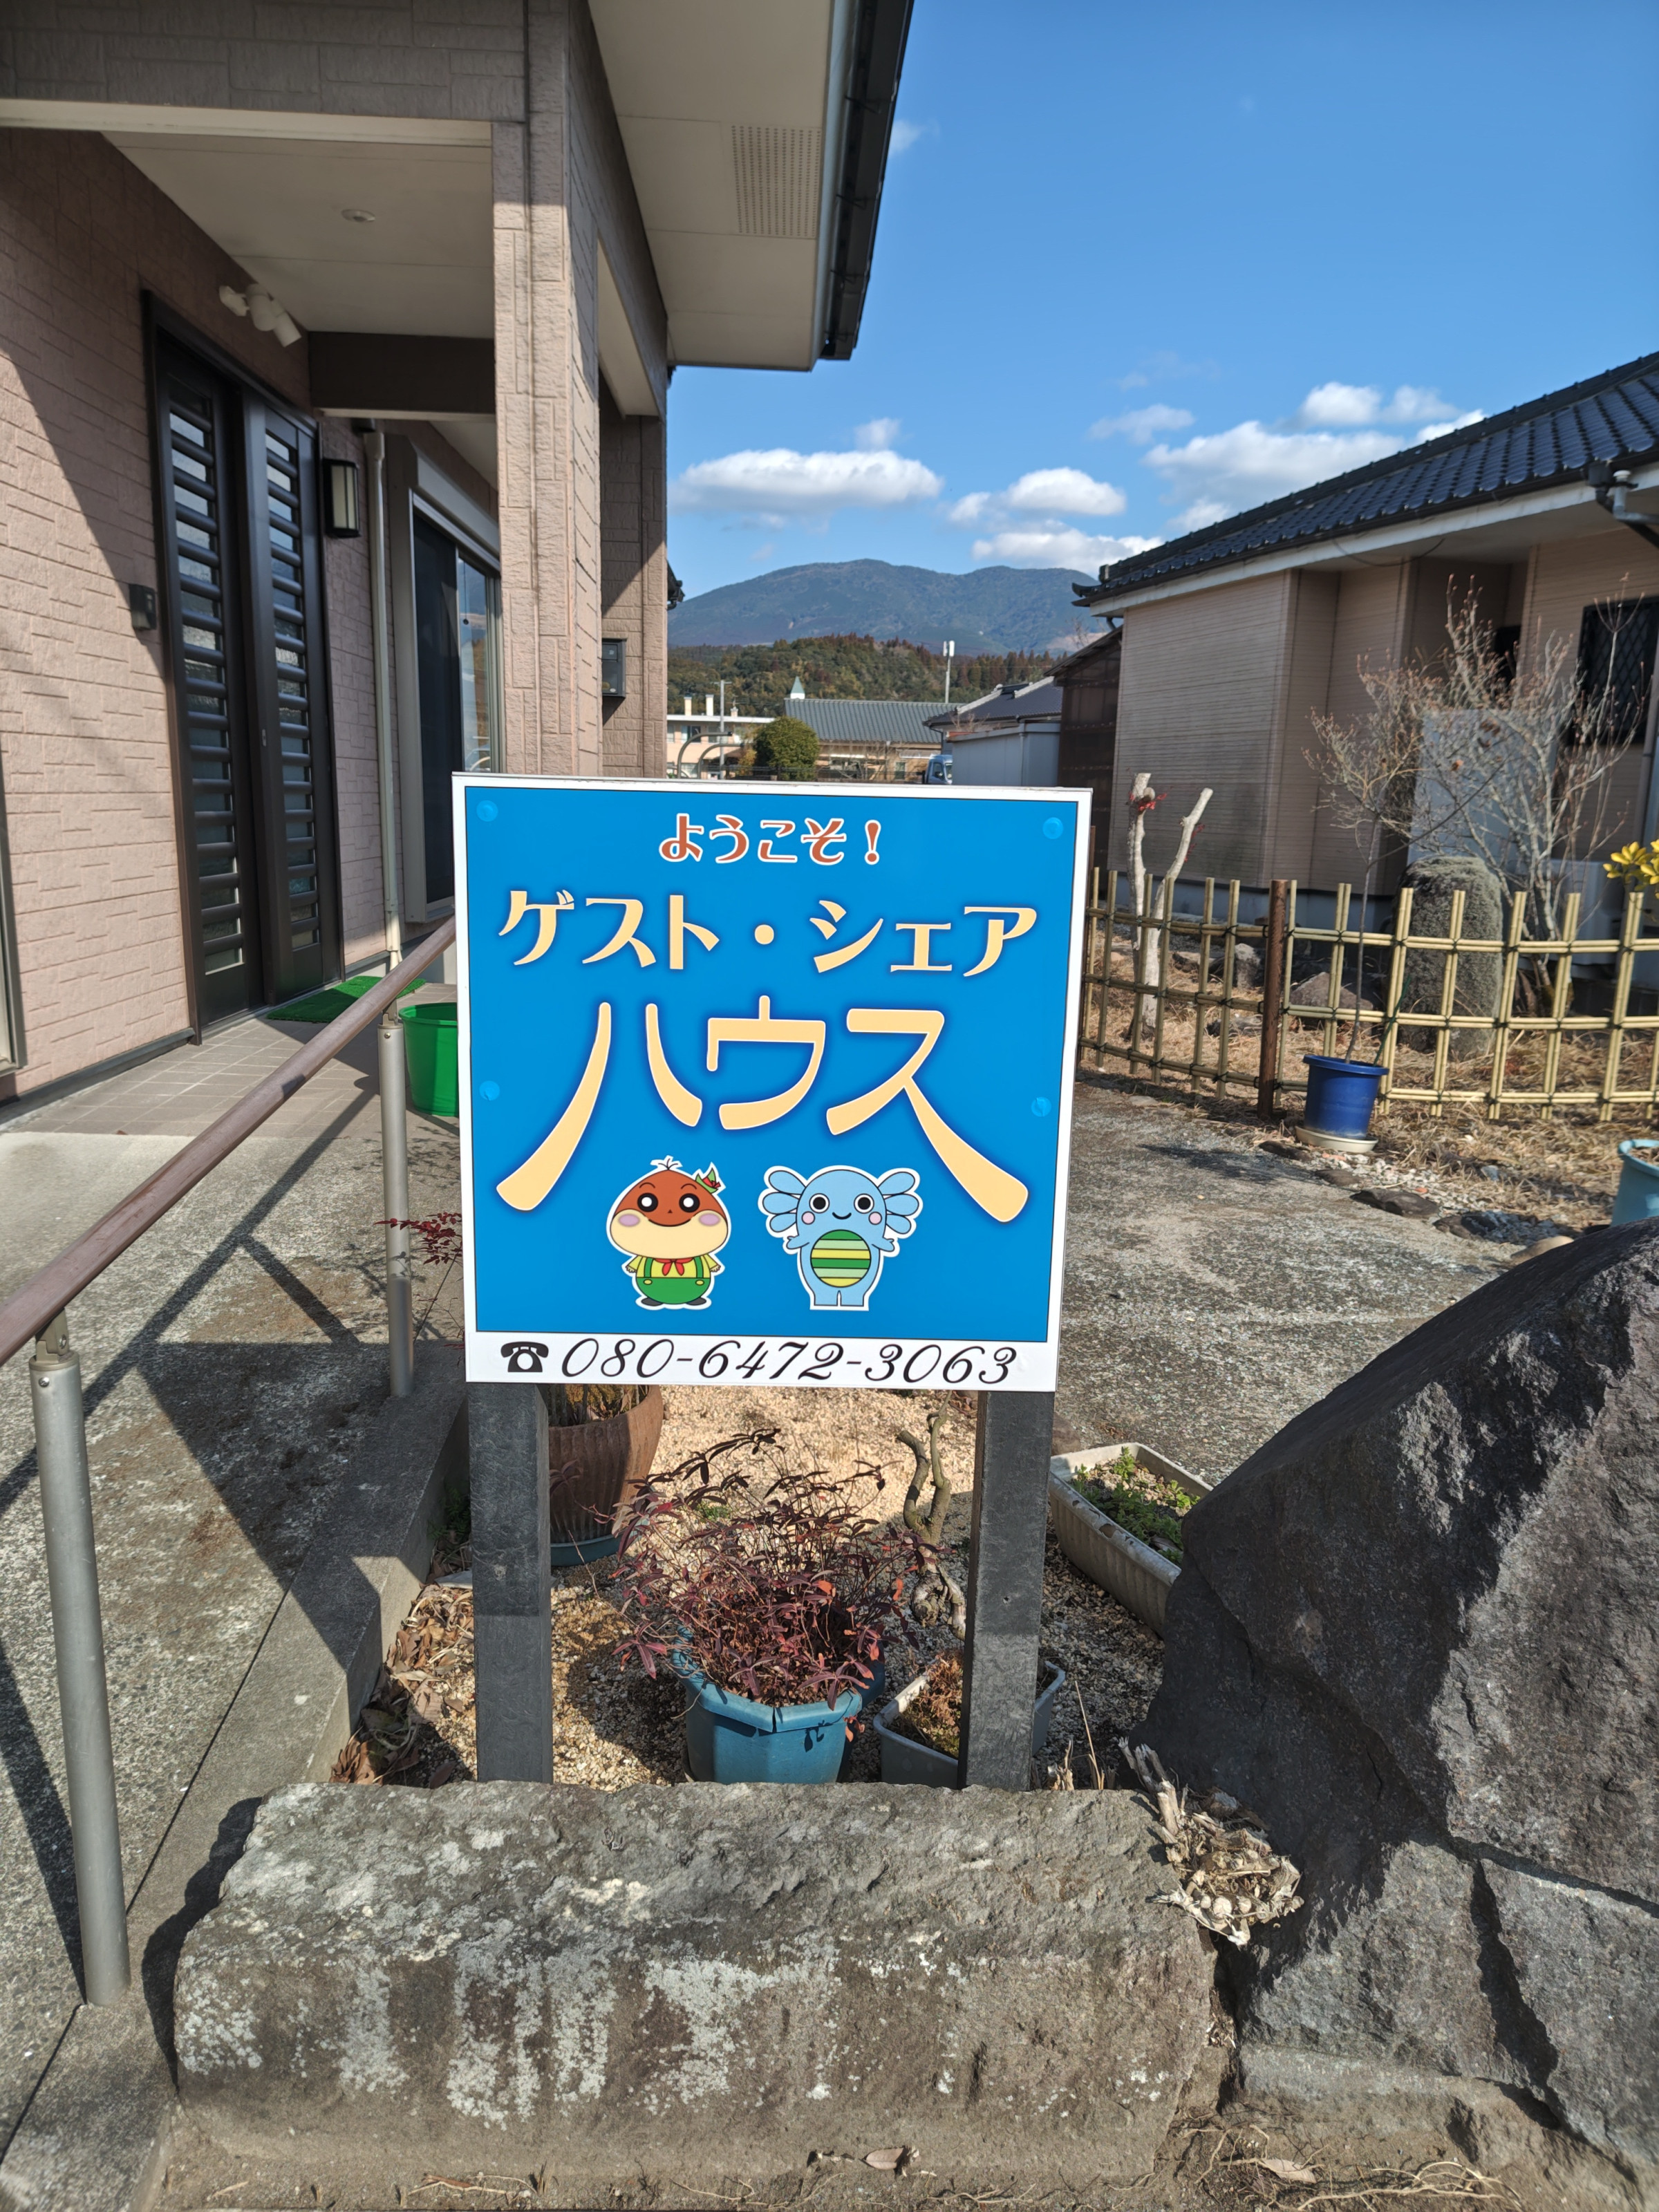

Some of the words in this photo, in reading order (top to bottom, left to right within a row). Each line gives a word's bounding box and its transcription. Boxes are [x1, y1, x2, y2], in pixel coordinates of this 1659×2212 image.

[658, 813, 882, 865] ようこそ！
[498, 889, 1038, 977] ゲスト・シェア
[496, 995, 1029, 1223] ハウス
[561, 1338, 1018, 1385] 080-6472-3063
